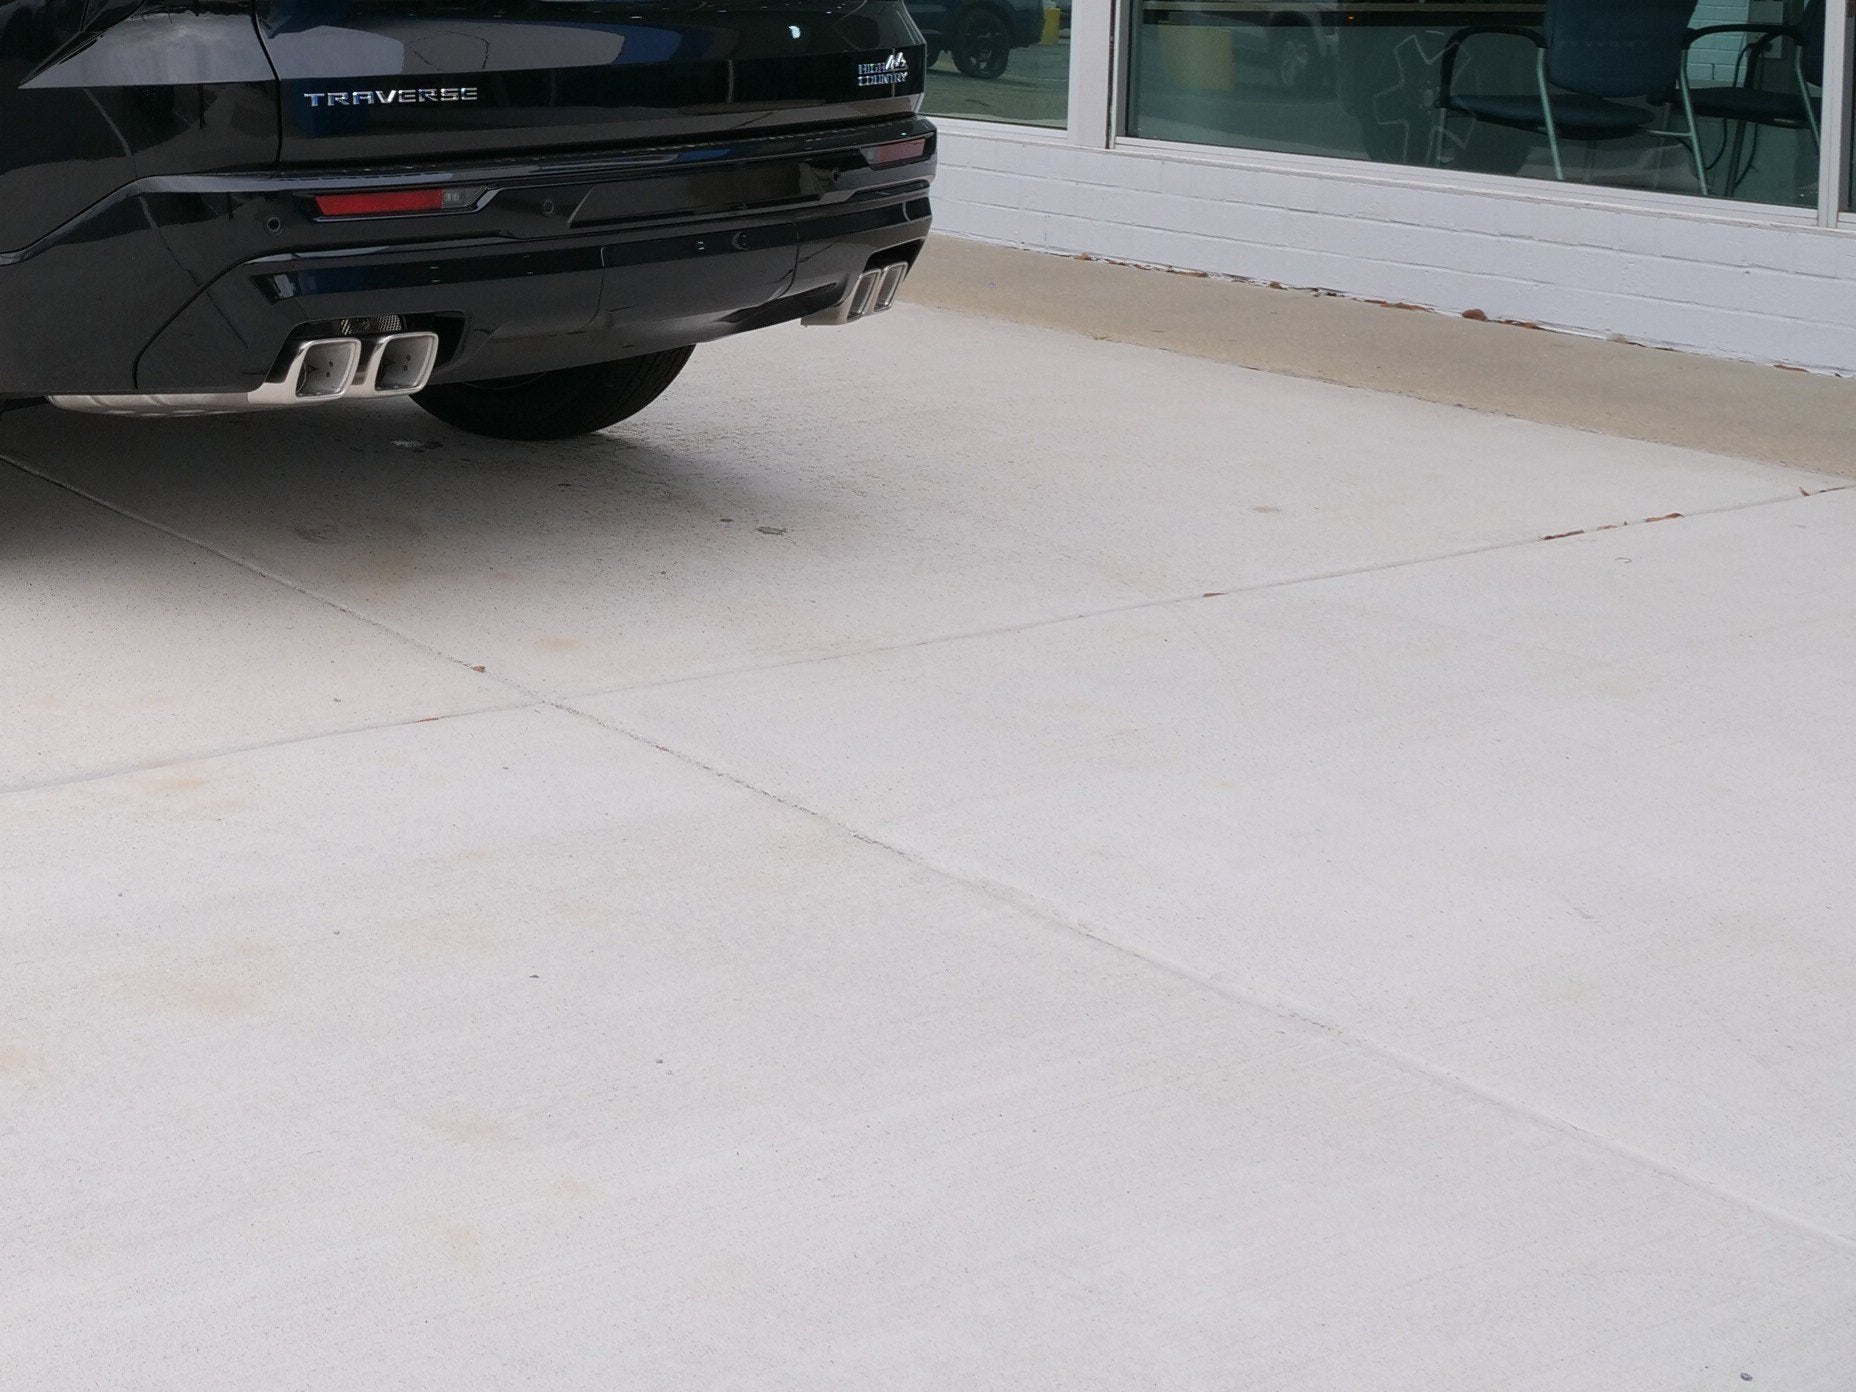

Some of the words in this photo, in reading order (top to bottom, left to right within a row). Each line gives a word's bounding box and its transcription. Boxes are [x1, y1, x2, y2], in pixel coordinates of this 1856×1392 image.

[858, 63, 887, 75] HIGH
[857, 71, 908, 86] COUNTRY
[303, 87, 478, 107] TRAVERSE
